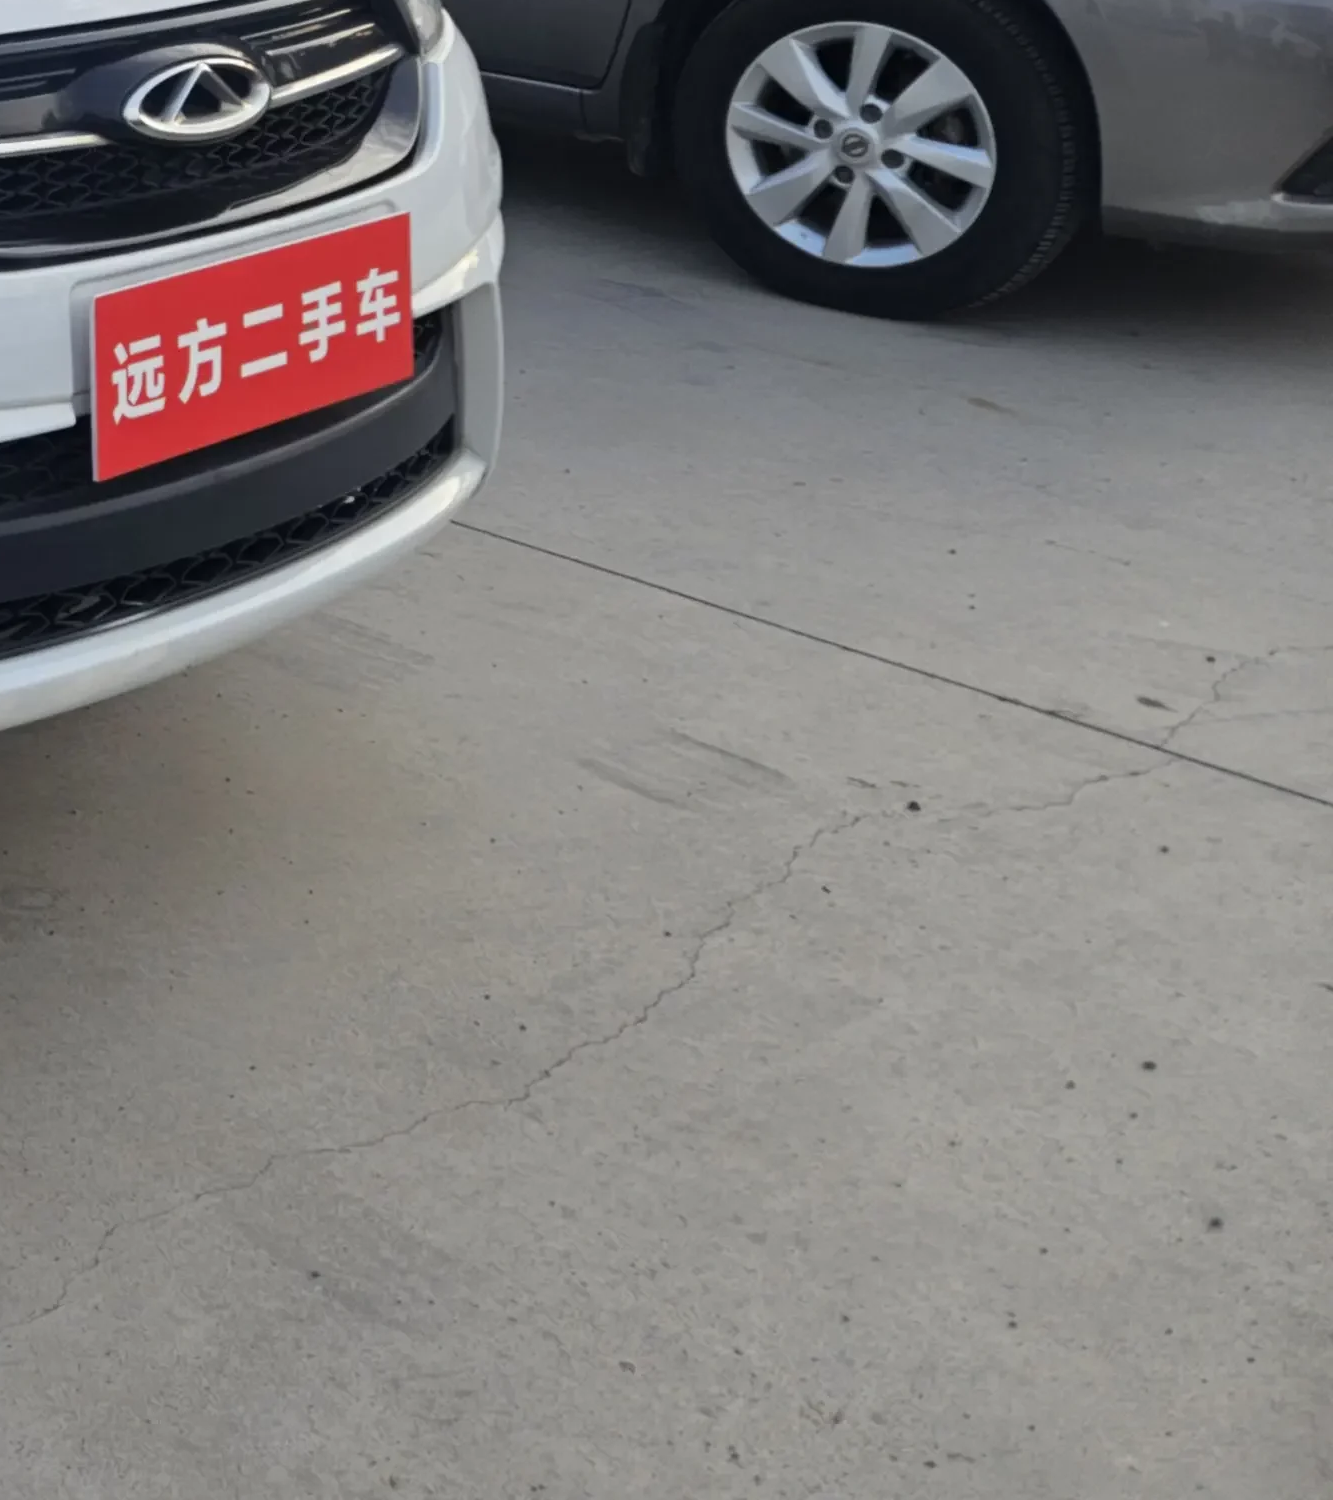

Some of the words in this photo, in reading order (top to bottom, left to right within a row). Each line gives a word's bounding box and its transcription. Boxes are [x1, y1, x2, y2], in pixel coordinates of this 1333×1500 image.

[111, 267, 402, 425] 远方二手车
